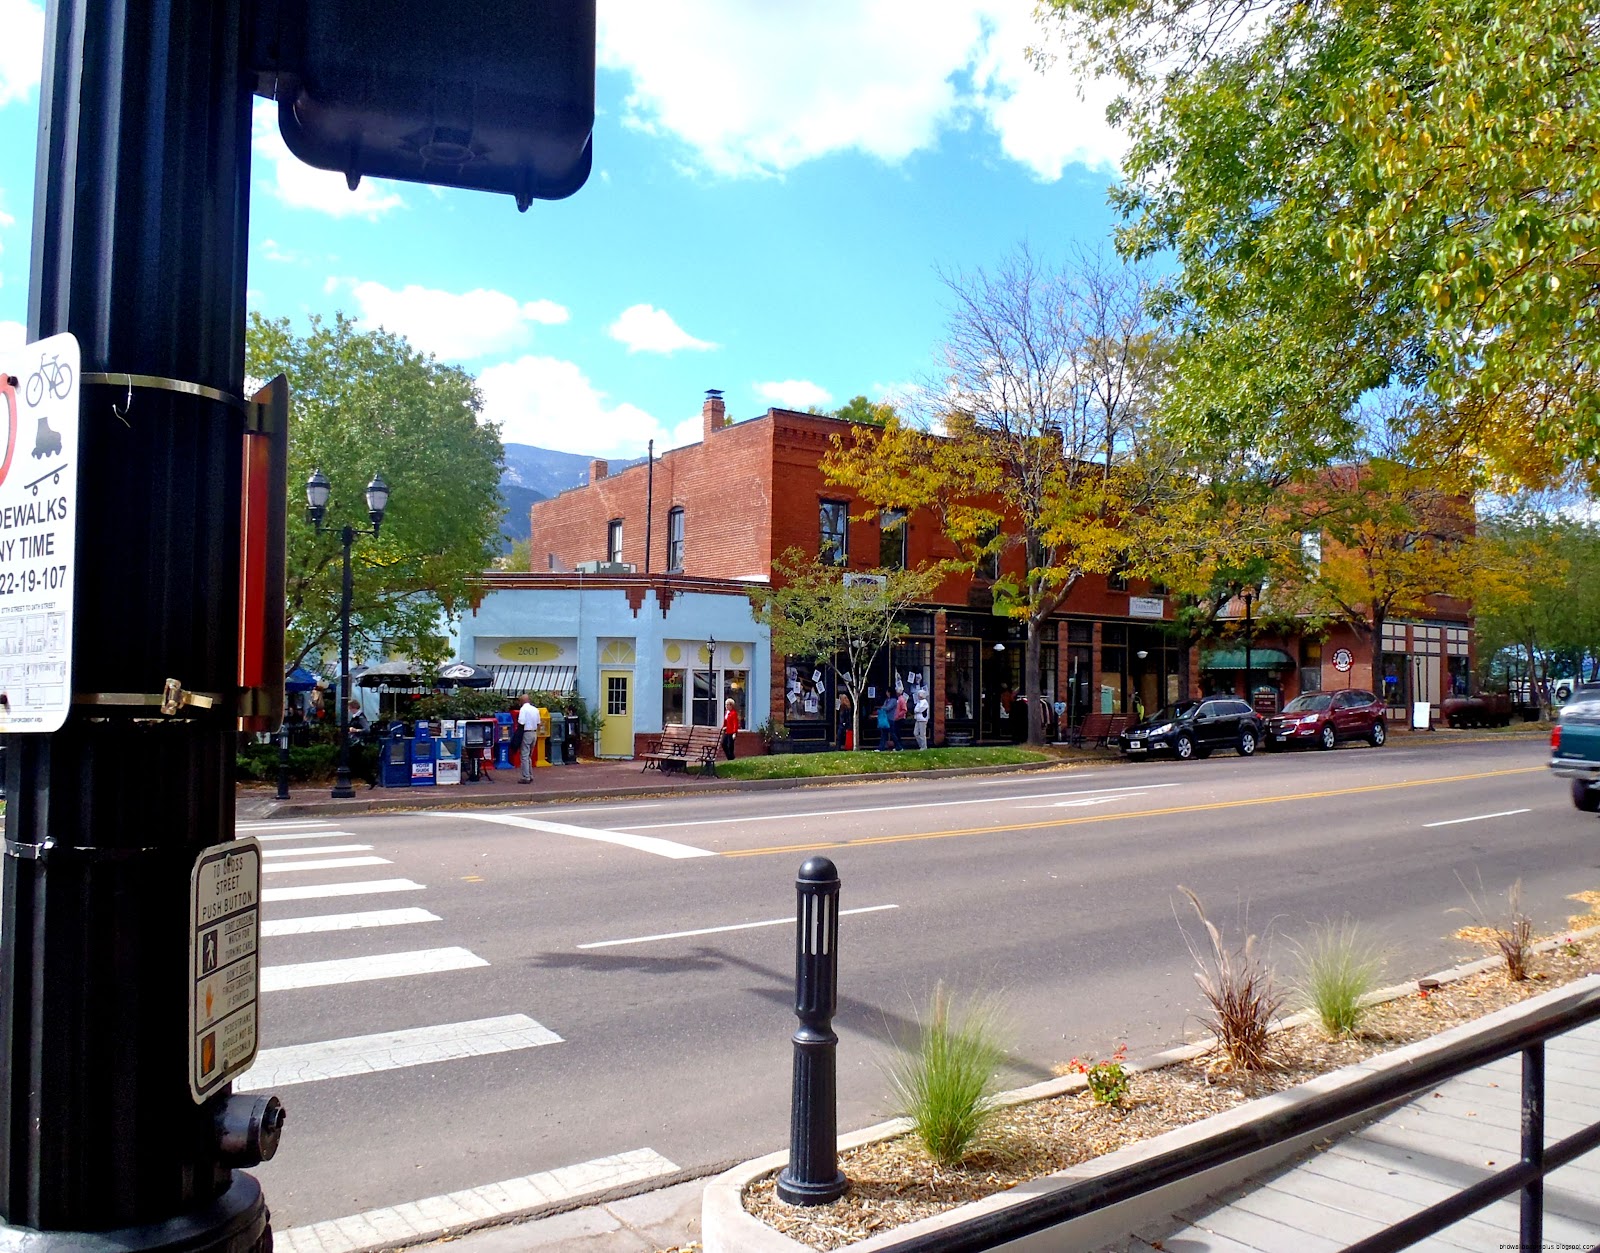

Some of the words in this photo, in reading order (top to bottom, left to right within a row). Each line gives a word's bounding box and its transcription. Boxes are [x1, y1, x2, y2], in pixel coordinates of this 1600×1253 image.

[0, 496, 67, 530] EWALKS
[20, 533, 55, 559] TIME
[518, 647, 539, 656] 2601
[213, 864, 220, 879] TO
[216, 875, 240, 896] STREET
[203, 901, 222, 920] PUSH
[225, 890, 252, 912] BUTTON
[224, 1012, 252, 1035] PEDESTRIANS
